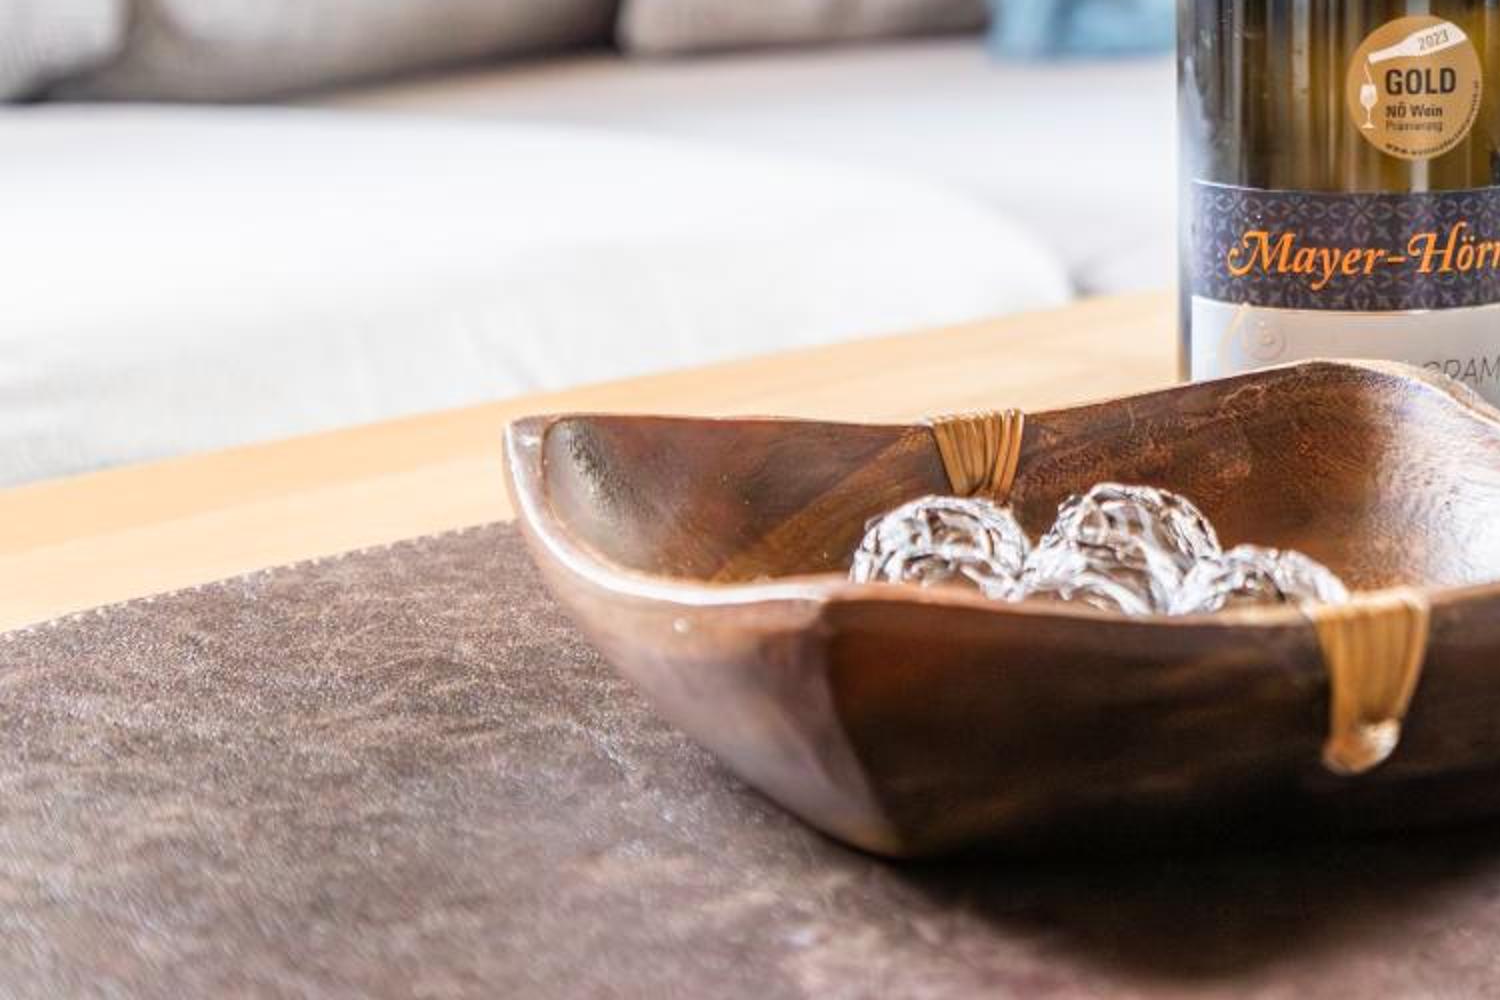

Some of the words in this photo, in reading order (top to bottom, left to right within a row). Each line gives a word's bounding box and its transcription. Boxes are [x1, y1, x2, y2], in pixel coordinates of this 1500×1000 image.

[1417, 29, 1449, 51] 2023
[1385, 67, 1456, 95] GOLD
[1411, 103, 1443, 118] Wein
